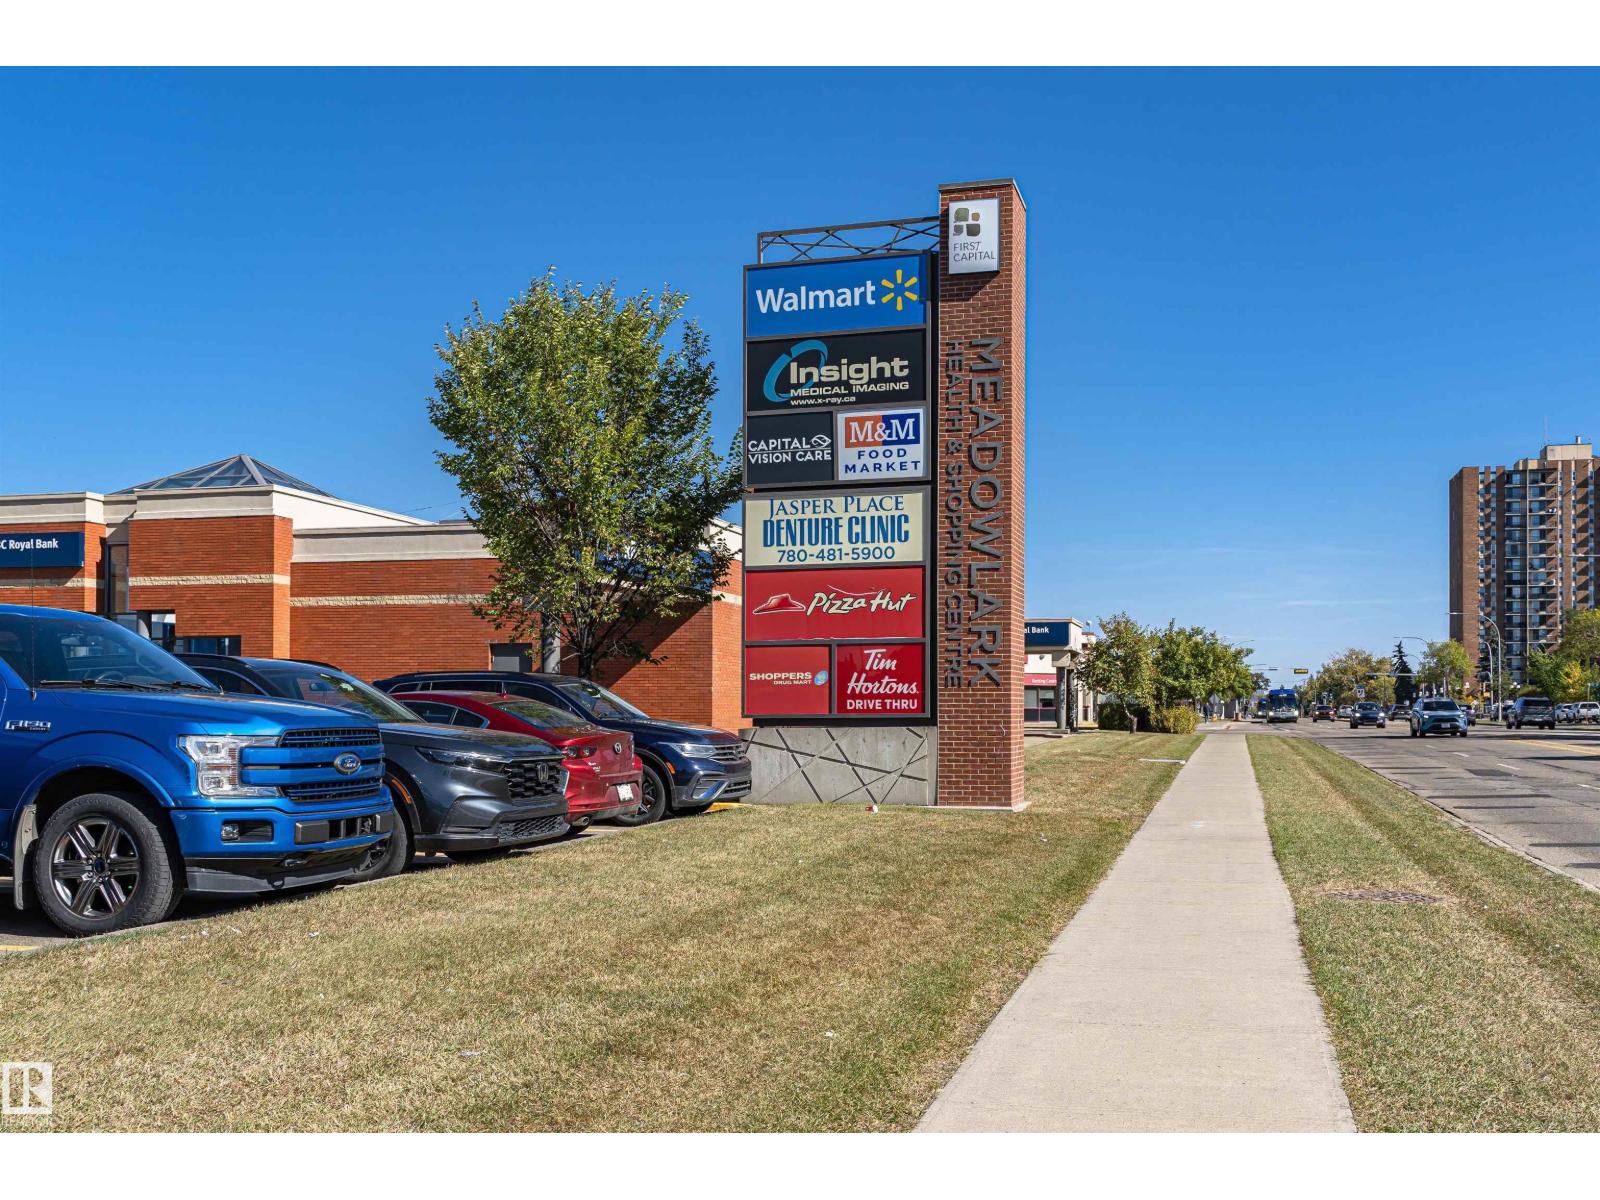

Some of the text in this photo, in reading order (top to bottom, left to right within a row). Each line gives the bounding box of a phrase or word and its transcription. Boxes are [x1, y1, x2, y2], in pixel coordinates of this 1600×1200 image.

[954, 241, 981, 251] FIRST
[953, 251, 996, 262] CAPITAL
[756, 280, 876, 313] Walmart
[789, 356, 909, 385] Insight
[790, 382, 909, 397] MEDICAL IMAGING
[790, 395, 856, 405] www.x-ray.ca
[849, 418, 916, 443] M&M
[748, 437, 811, 451] CAPITAL
[748, 450, 832, 464] VISION CARE
[857, 448, 907, 460] FOOD
[844, 461, 921, 473] MARKET
[769, 495, 905, 519] JASPER PLACE
[944, 339, 964, 688] HEALTH & SHOPPING CENTRE
[969, 337, 1003, 687] MEADOWLARK
[762, 514, 910, 547] DENTURE CLINIC
[9, 539, 34, 551] Royal
[36, 538, 59, 549] Bank
[777, 546, 896, 562] 780-481-5900
[806, 590, 918, 615] Pizza Hut
[1031, 626, 1050, 634] Bank
[863, 649, 897, 671] Tim
[749, 671, 812, 681] SHOPPERS
[847, 672, 917, 695] Hortons
[846, 698, 918, 710] DRIVE THRU
